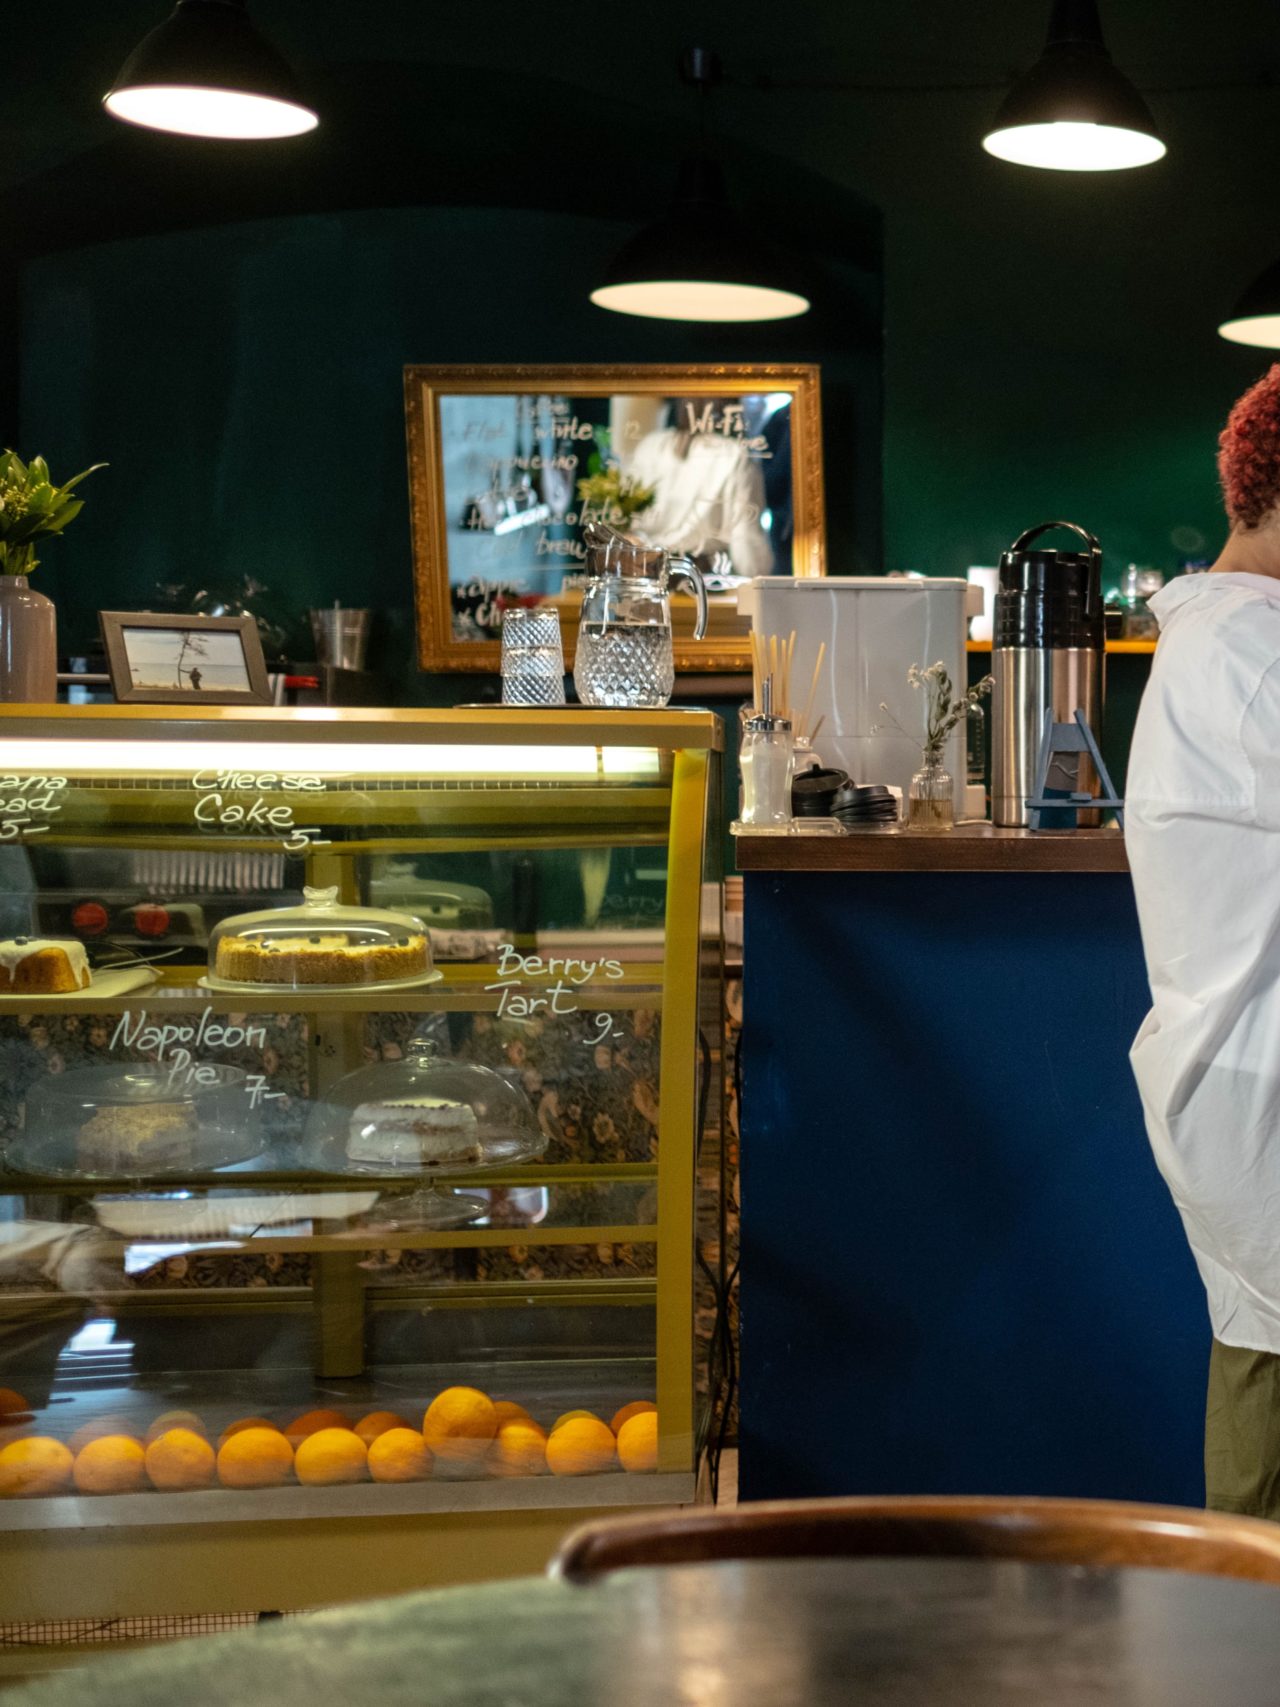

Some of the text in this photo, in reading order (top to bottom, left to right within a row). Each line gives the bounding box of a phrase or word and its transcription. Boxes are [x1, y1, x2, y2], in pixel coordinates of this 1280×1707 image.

[192, 768, 326, 790] Cheese
[194, 793, 295, 826] Cake
[497, 944, 625, 983] Berry's
[485, 980, 578, 1018] Tart
[109, 1006, 266, 1062] Napoleon
[167, 1049, 221, 1087] Pie
